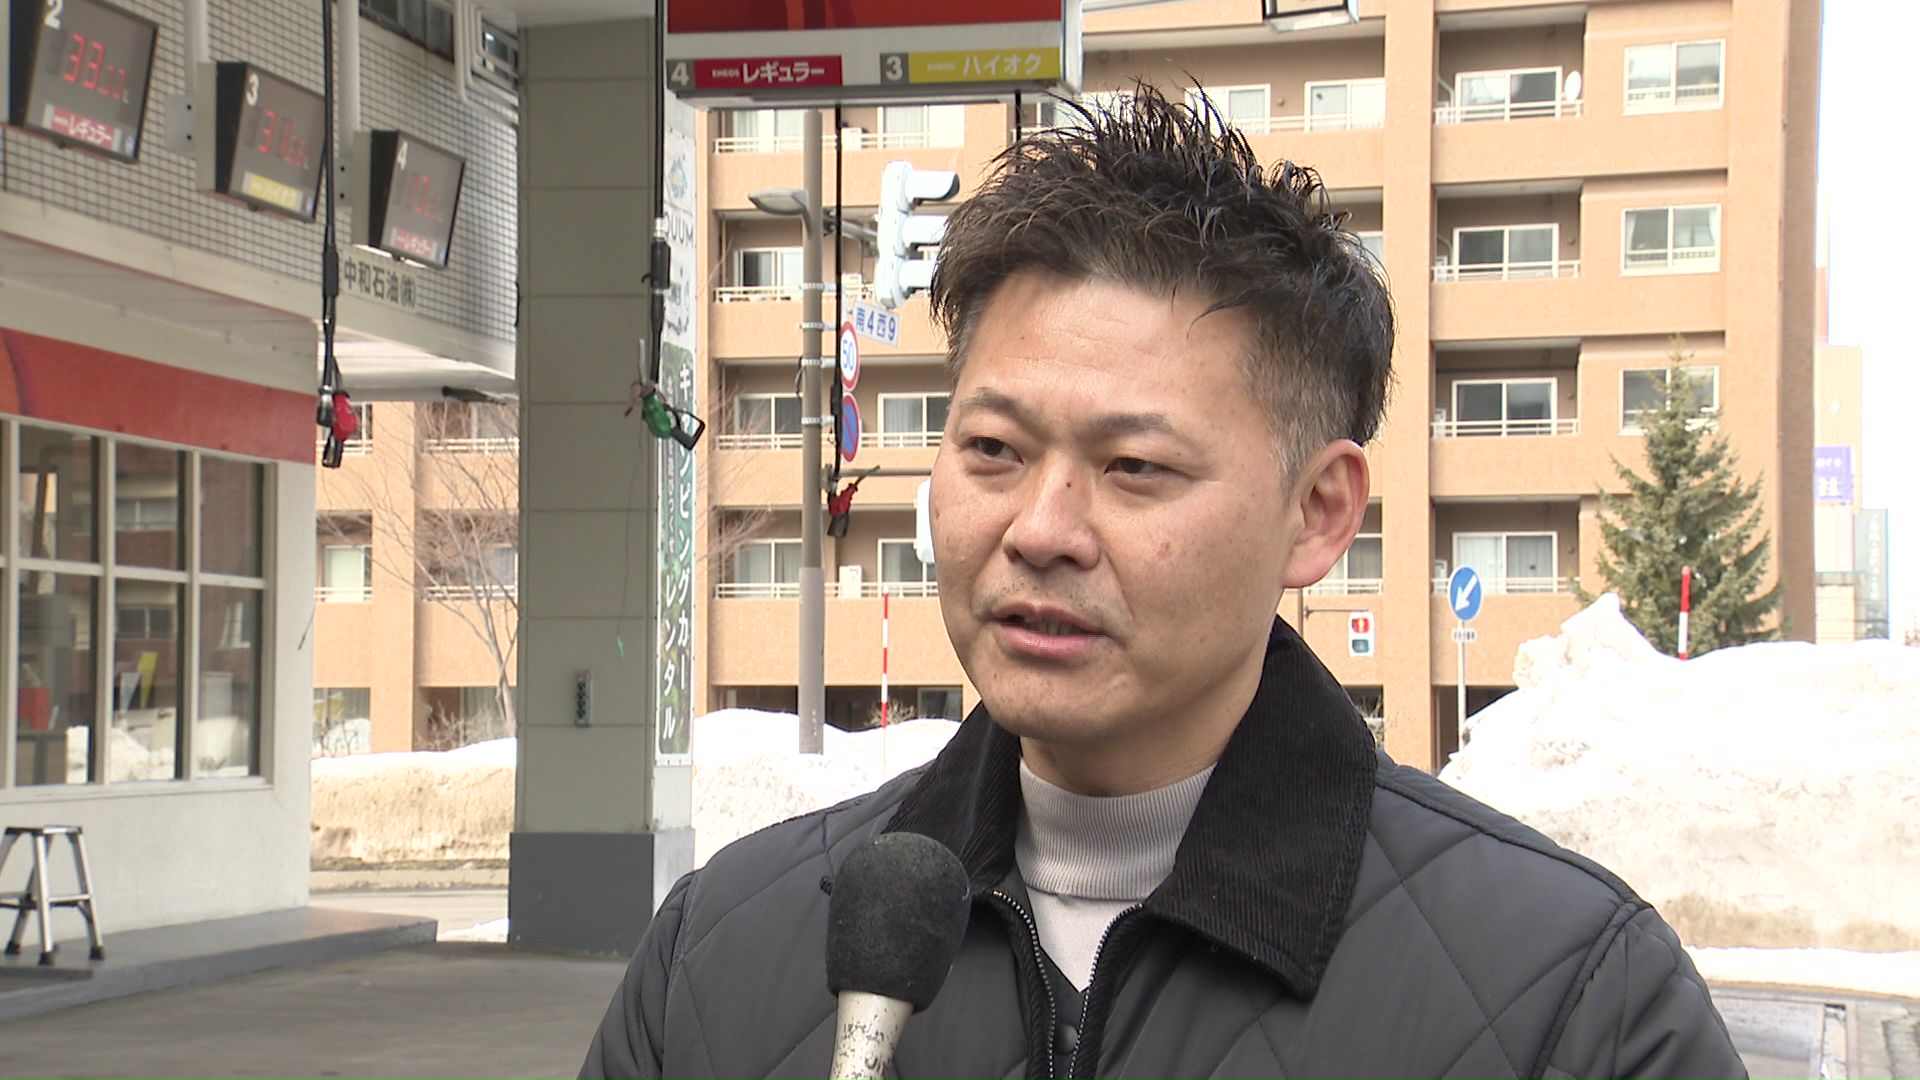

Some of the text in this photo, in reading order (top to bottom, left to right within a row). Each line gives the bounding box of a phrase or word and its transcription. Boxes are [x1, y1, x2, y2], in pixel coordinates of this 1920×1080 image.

[44, 0, 63, 29] 2
[671, 62, 689, 86] 4
[742, 61, 825, 84] レギュラー
[885, 56, 903, 80] 3
[963, 53, 1042, 77] ハイオク
[246, 73, 260, 106] 3
[396, 141, 408, 171] 4
[855, 307, 897, 342] 南4西9
[842, 340, 855, 371] 50
[662, 575, 677, 740] レンタル
